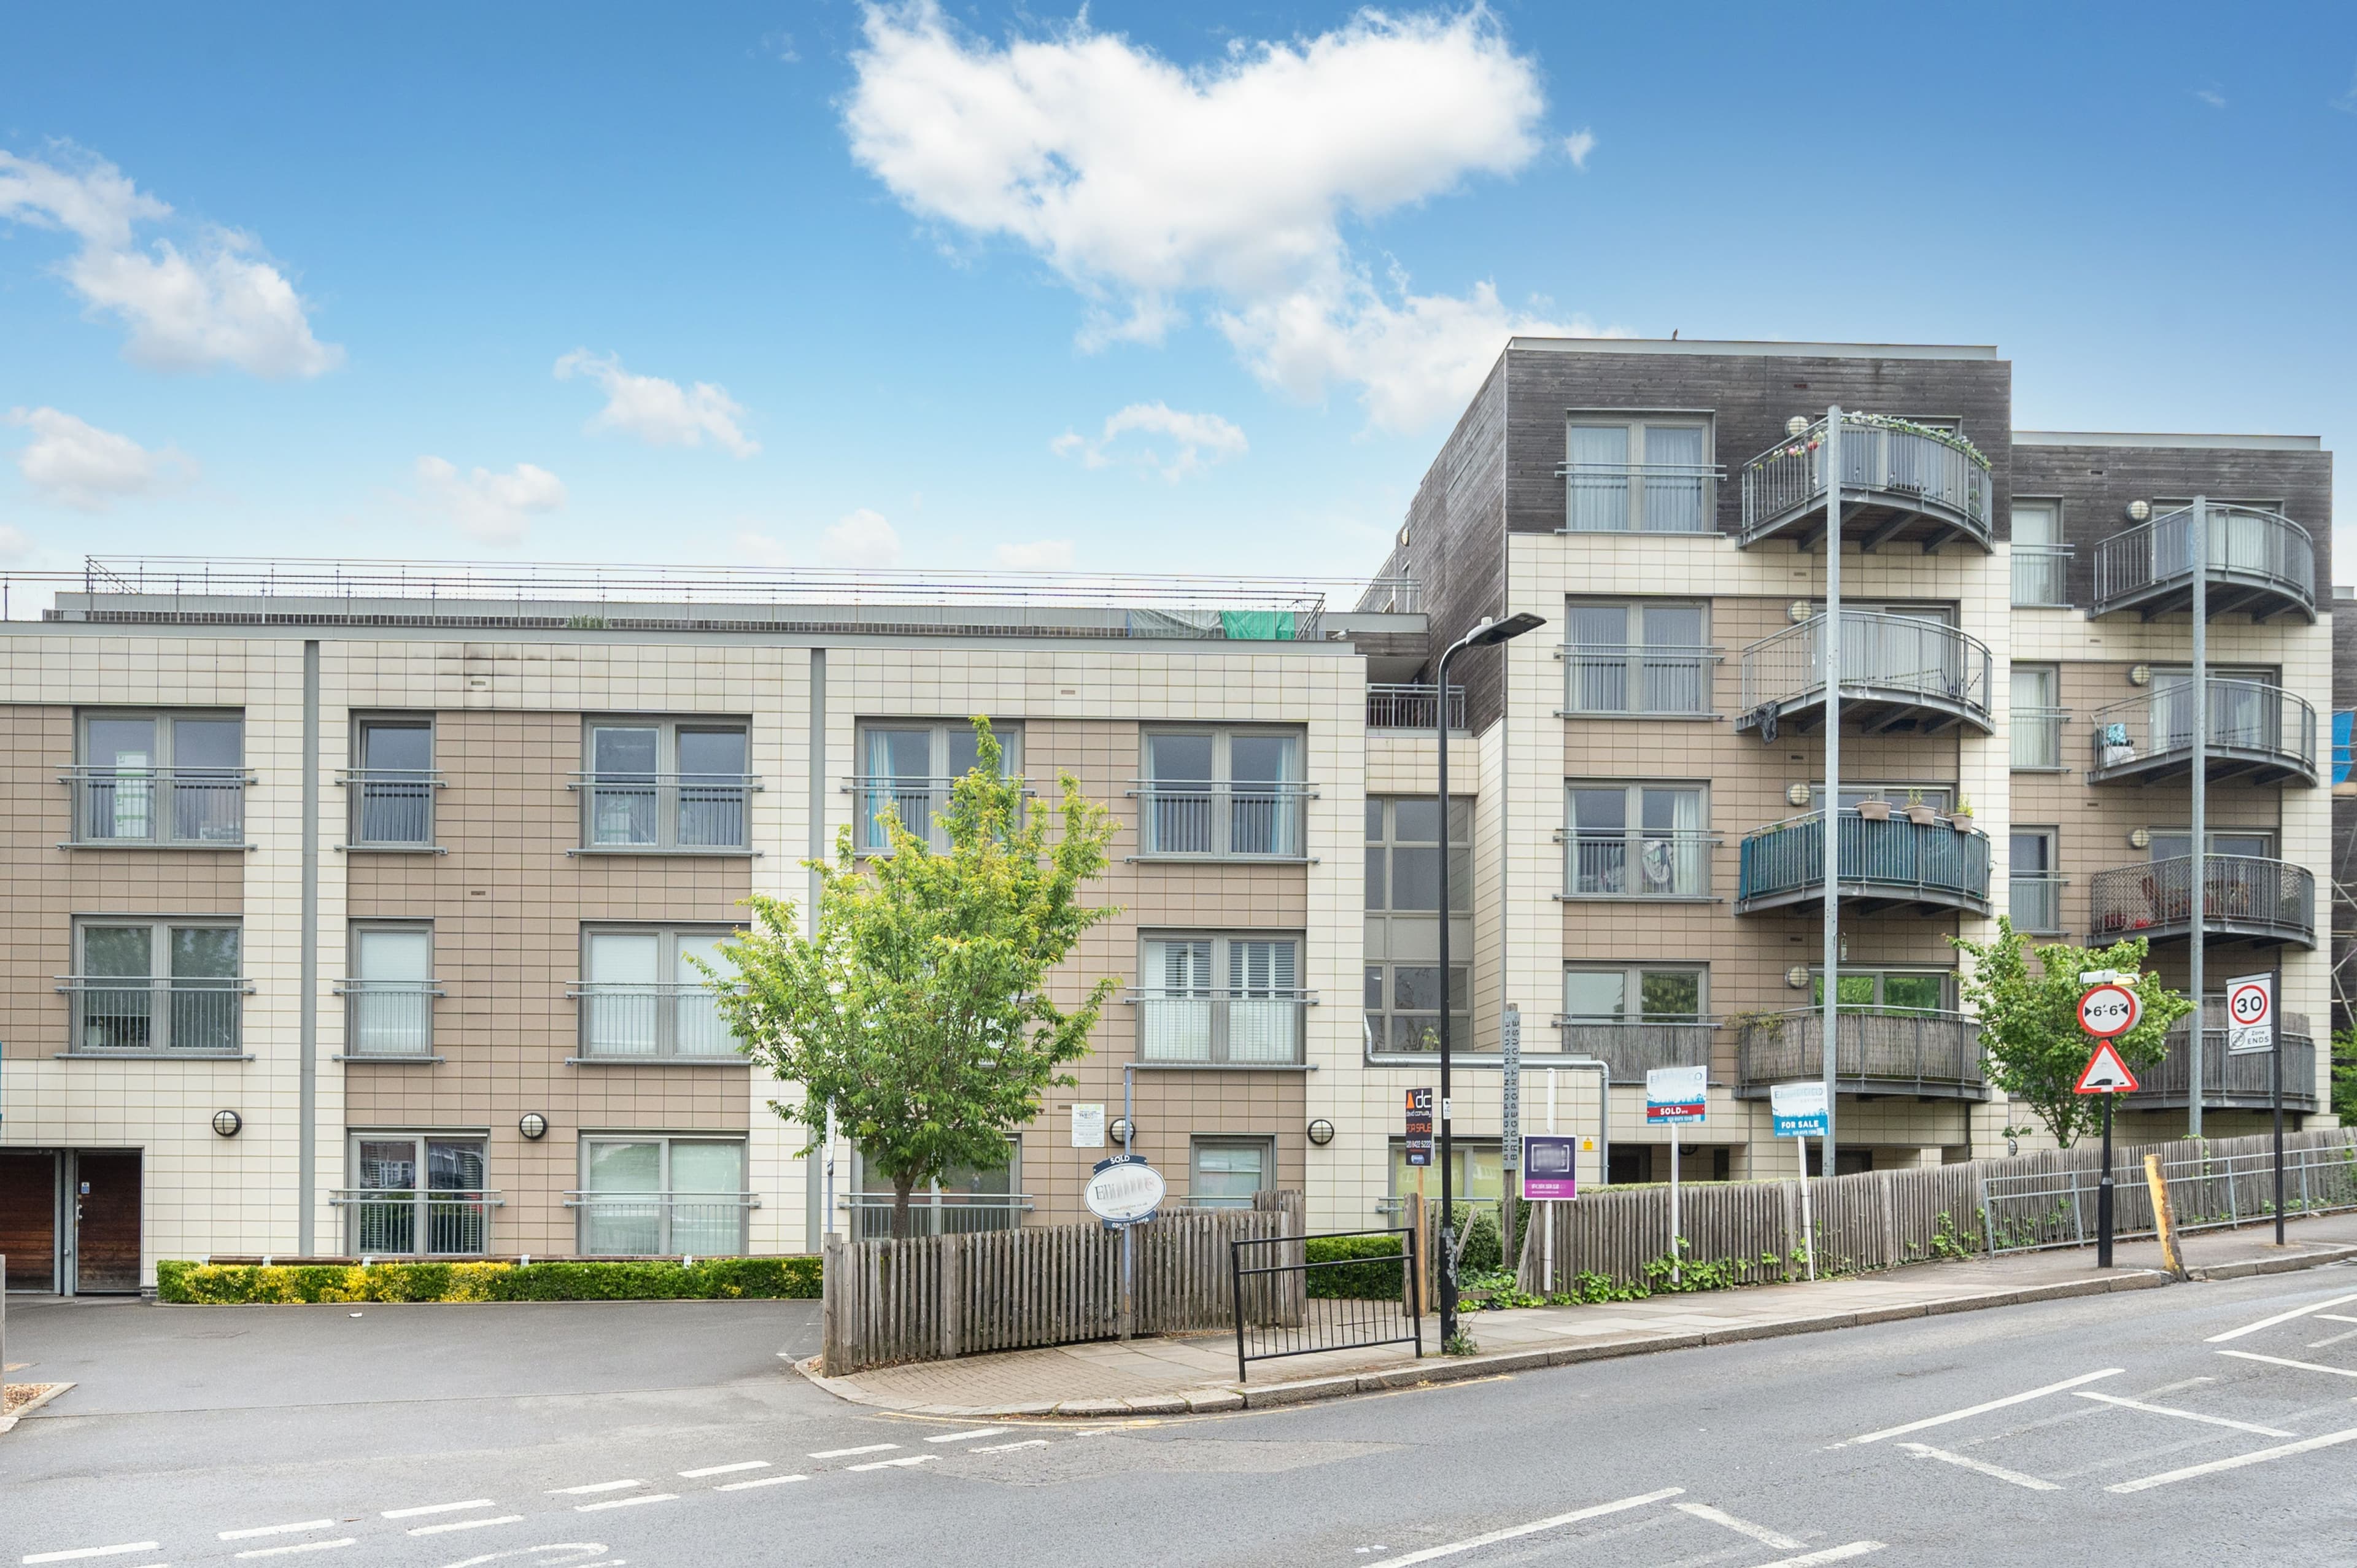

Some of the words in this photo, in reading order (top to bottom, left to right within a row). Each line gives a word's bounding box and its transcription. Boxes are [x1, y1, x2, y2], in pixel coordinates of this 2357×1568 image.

[2237, 996, 2262, 1013] 30
[2247, 1036, 2269, 1045] ENDS
[1660, 1106, 1681, 1115] SOLD
[1416, 1123, 1431, 1132] SALE
[1110, 1155, 1130, 1164] SOLD
